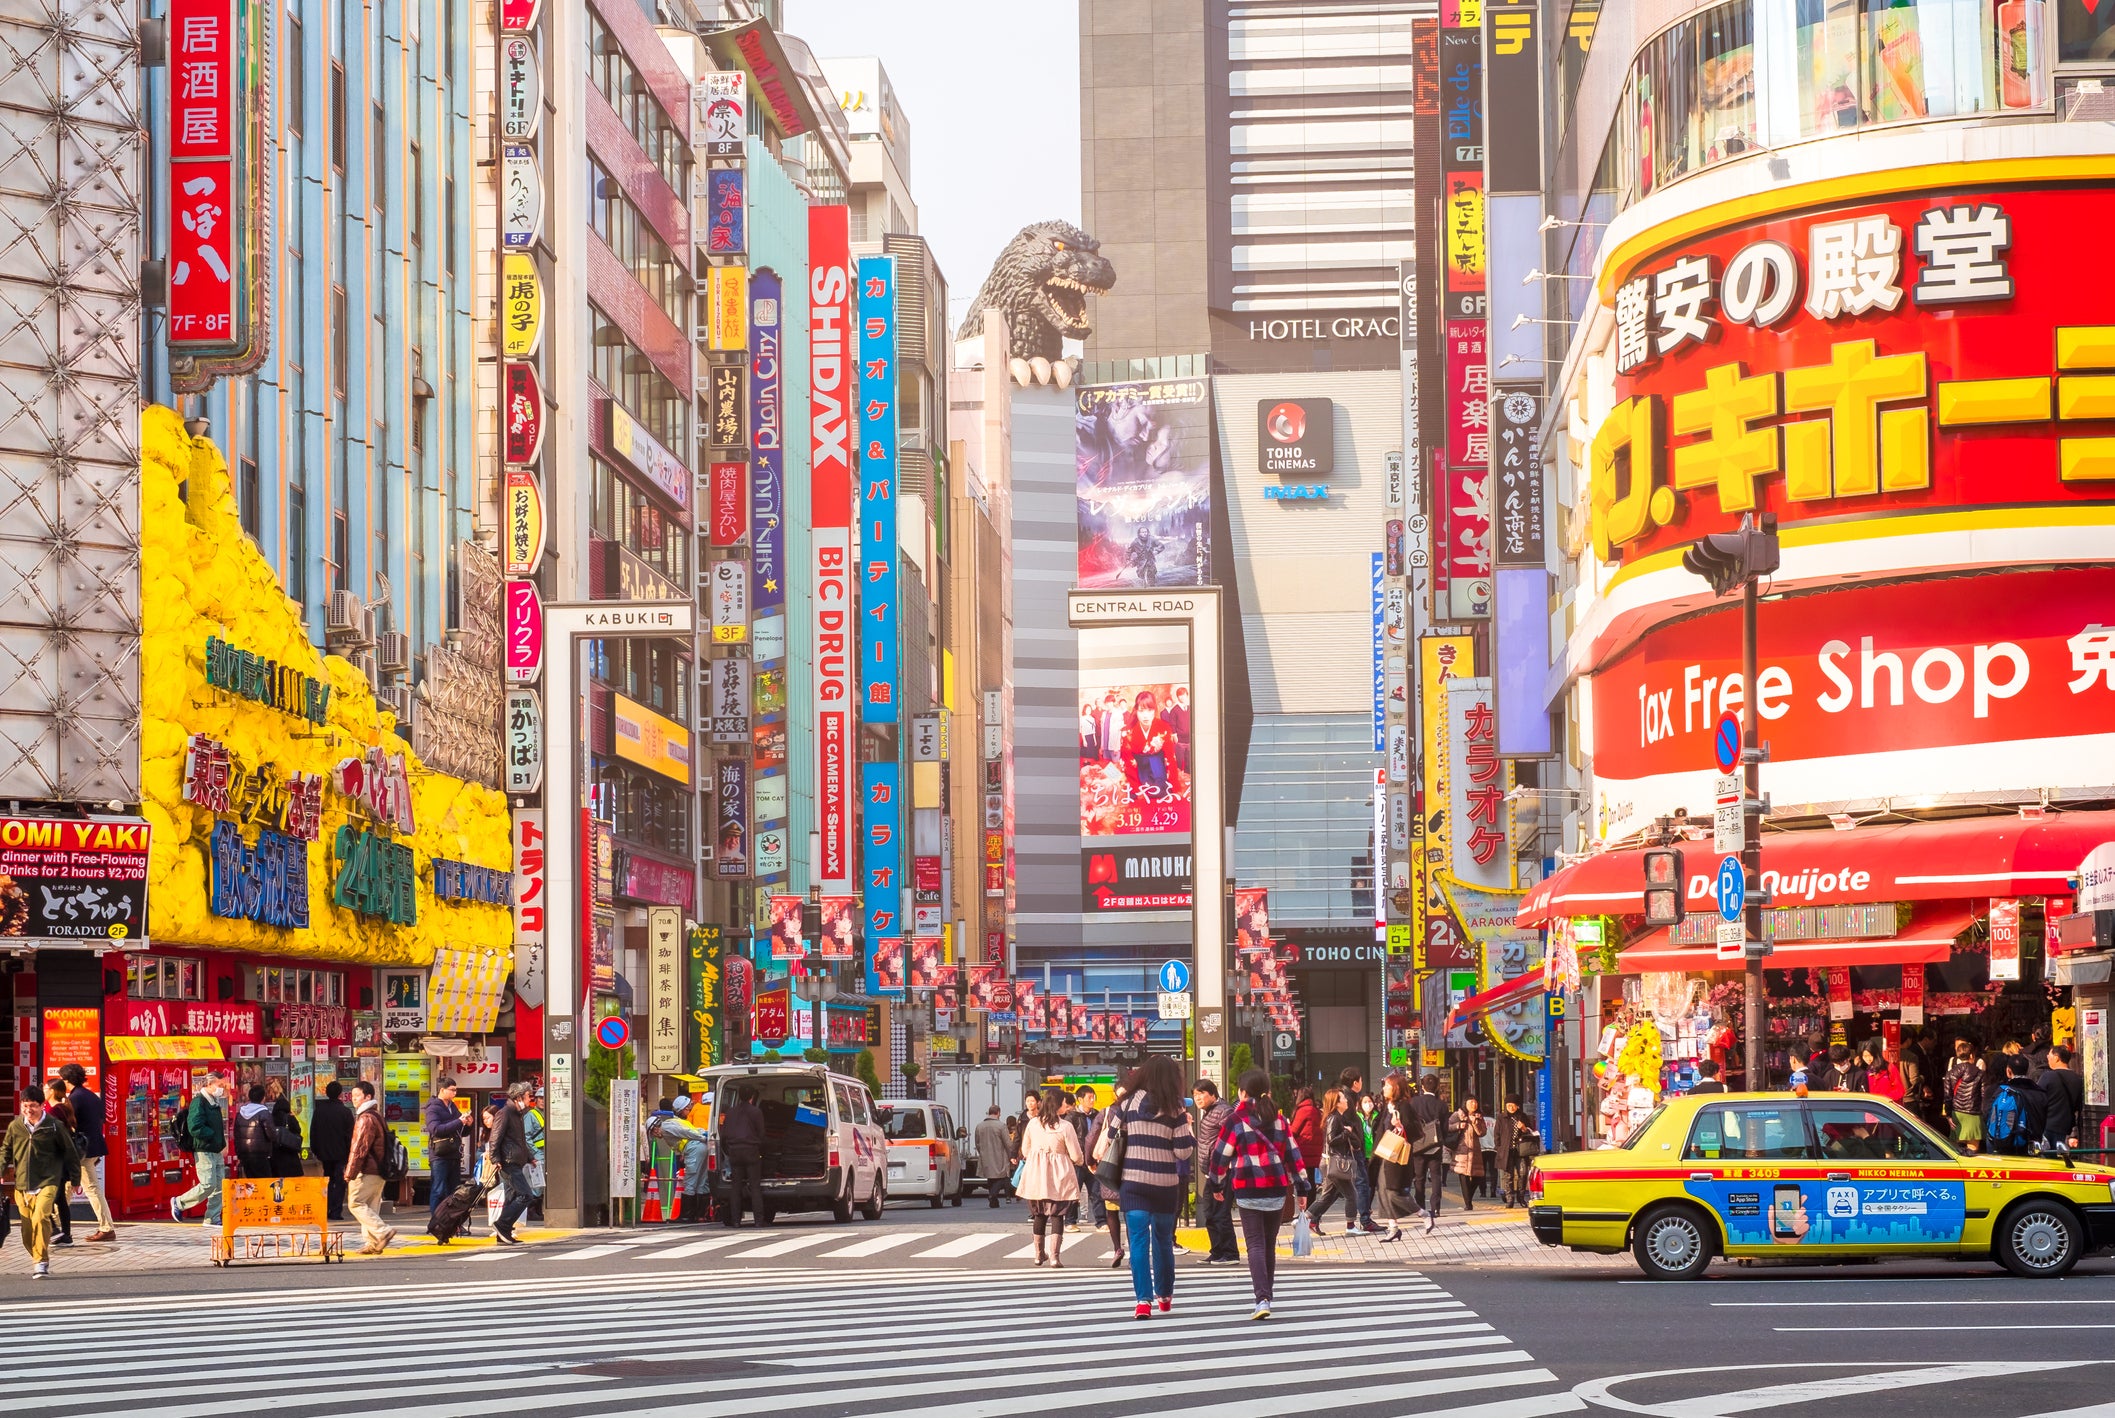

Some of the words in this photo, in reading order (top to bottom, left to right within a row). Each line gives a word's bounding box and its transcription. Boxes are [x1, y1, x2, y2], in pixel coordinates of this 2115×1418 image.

[506, 17, 525, 26] 7F
[1445, 35, 1468, 46] New
[181, 16, 220, 145] 居酒屋
[509, 58, 525, 111] ヤキトリ
[1448, 63, 1470, 91] de
[1449, 96, 1470, 139] Elle
[506, 121, 529, 135] 6F
[717, 143, 732, 153] 8F
[1459, 148, 1483, 160] 7F
[172, 176, 231, 286] つぼ八
[510, 234, 525, 244] 5F
[1616, 204, 2012, 374] 驚安の殿堂
[508, 282, 535, 331] 虎の子
[1461, 296, 1486, 314] 6F
[1250, 319, 1327, 340] HOTEL
[508, 341, 525, 350] 4F
[1458, 342, 1487, 354] 居酒
[812, 266, 847, 469] SHIDAX
[716, 369, 739, 434] 山内農場
[1266, 447, 1302, 459] TOHO
[1266, 459, 1316, 469] CINEMAS
[1389, 462, 1401, 504] 東京ビル
[1263, 484, 1330, 500] IMAX
[719, 467, 737, 537] 焼肉屋さかい
[515, 489, 529, 561] お好み焼き
[1412, 520, 1424, 528] 8F
[1413, 556, 1425, 564] 5F
[818, 547, 844, 601] BIC
[1076, 601, 1147, 613] CENTRAL
[1152, 600, 1194, 611] ROAD
[515, 588, 533, 663] プリクラ
[721, 627, 739, 640] 3F
[819, 611, 845, 701] DRUG
[515, 669, 531, 678] 1F
[721, 661, 741, 716] お好み焼
[1639, 683, 1674, 748] Tax
[1684, 664, 1793, 733] Free
[1816, 635, 2030, 719] Shop
[510, 699, 531, 709] 新宿
[826, 716, 839, 740] BIC
[510, 709, 532, 766] かっぱ
[513, 773, 530, 784] B1
[826, 744, 839, 804] CAMERA
[722, 765, 741, 817] 海の家
[1464, 702, 1505, 865] カラオケ
[1116, 813, 1142, 827] 3.19
[1151, 812, 1178, 826] 4.29
[0, 821, 62, 848] OMI
[73, 824, 149, 850] YAKI
[2, 851, 40, 862] dinner
[43, 853, 68, 863] with
[71, 853, 146, 867] Free-Flowing
[871, 782, 894, 930] カラオケ
[0, 865, 38, 875] Drinks
[41, 866, 58, 877] for
[61, 867, 69, 877] 2
[71, 867, 105, 877] hours
[108, 869, 145, 879] ¥2,700
[1724, 860, 1736, 870] 7-20
[1760, 867, 1870, 901] Quijote
[1722, 872, 1733, 913] P
[1730, 892, 1738, 911] 40
[47, 925, 107, 936] TORADYU
[111, 927, 126, 935] 2F
[1992, 928, 2011, 941] 100
[1305, 947, 1350, 960] TOHO
[658, 948, 673, 1010] 珈琲茶館
[1904, 977, 1919, 989] 100
[44, 1010, 98, 1020] OKONOMI
[759, 1008, 785, 1018] アダム
[58, 1020, 86, 1030] YAKI
[187, 1010, 254, 1034] 東京カラオケ本舗
[384, 1017, 425, 1029] 虎の子
[656, 1016, 676, 1037] 集
[456, 1063, 499, 1074] トラノコ
[1749, 1169, 1780, 1178] 3409
[1858, 1169, 1886, 1178] NIKKO
[1889, 1170, 1925, 1178] NERIMA
[1967, 1169, 2011, 1180] TAXI
[1863, 1188, 1957, 1201] アプリで呼べる。
